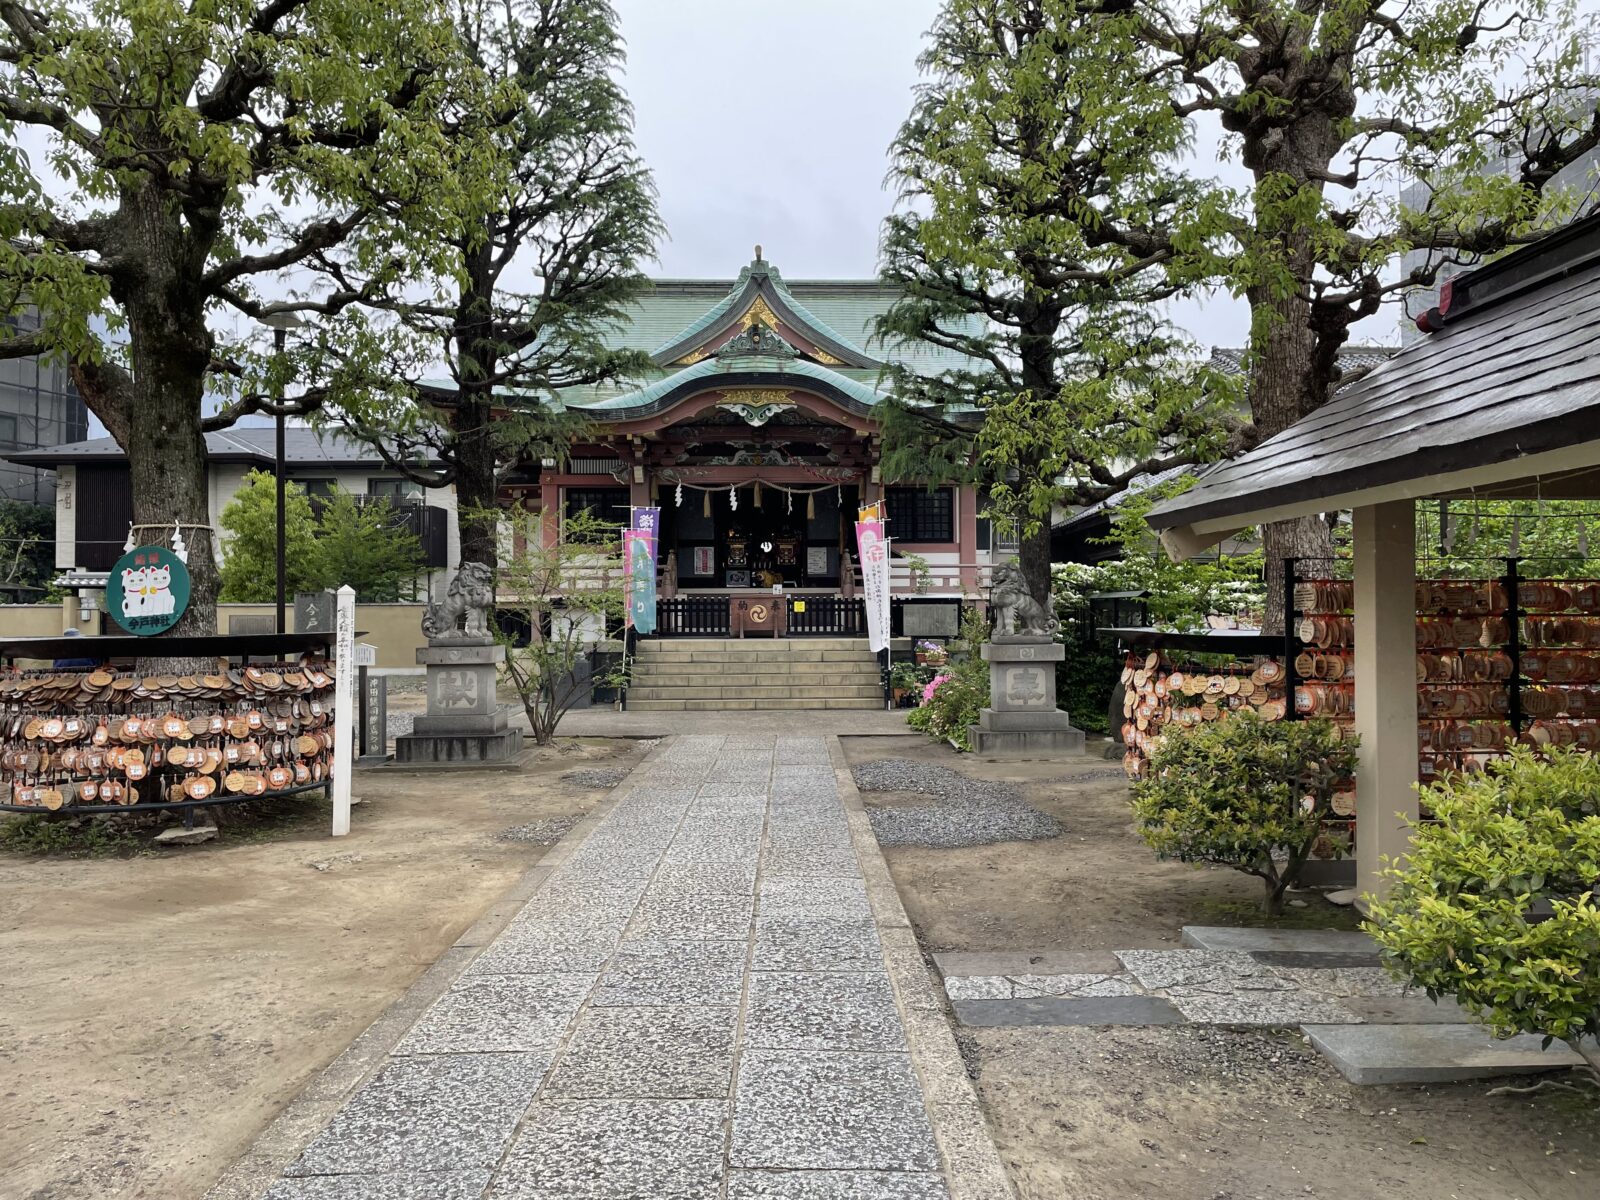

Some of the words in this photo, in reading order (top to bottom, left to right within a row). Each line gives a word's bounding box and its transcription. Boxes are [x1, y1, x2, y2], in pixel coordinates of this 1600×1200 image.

[128, 616, 171, 630] 今戸神社
[305, 603, 320, 630] 今戸
[437, 670, 477, 708] 献
[1008, 668, 1043, 704] 奉
